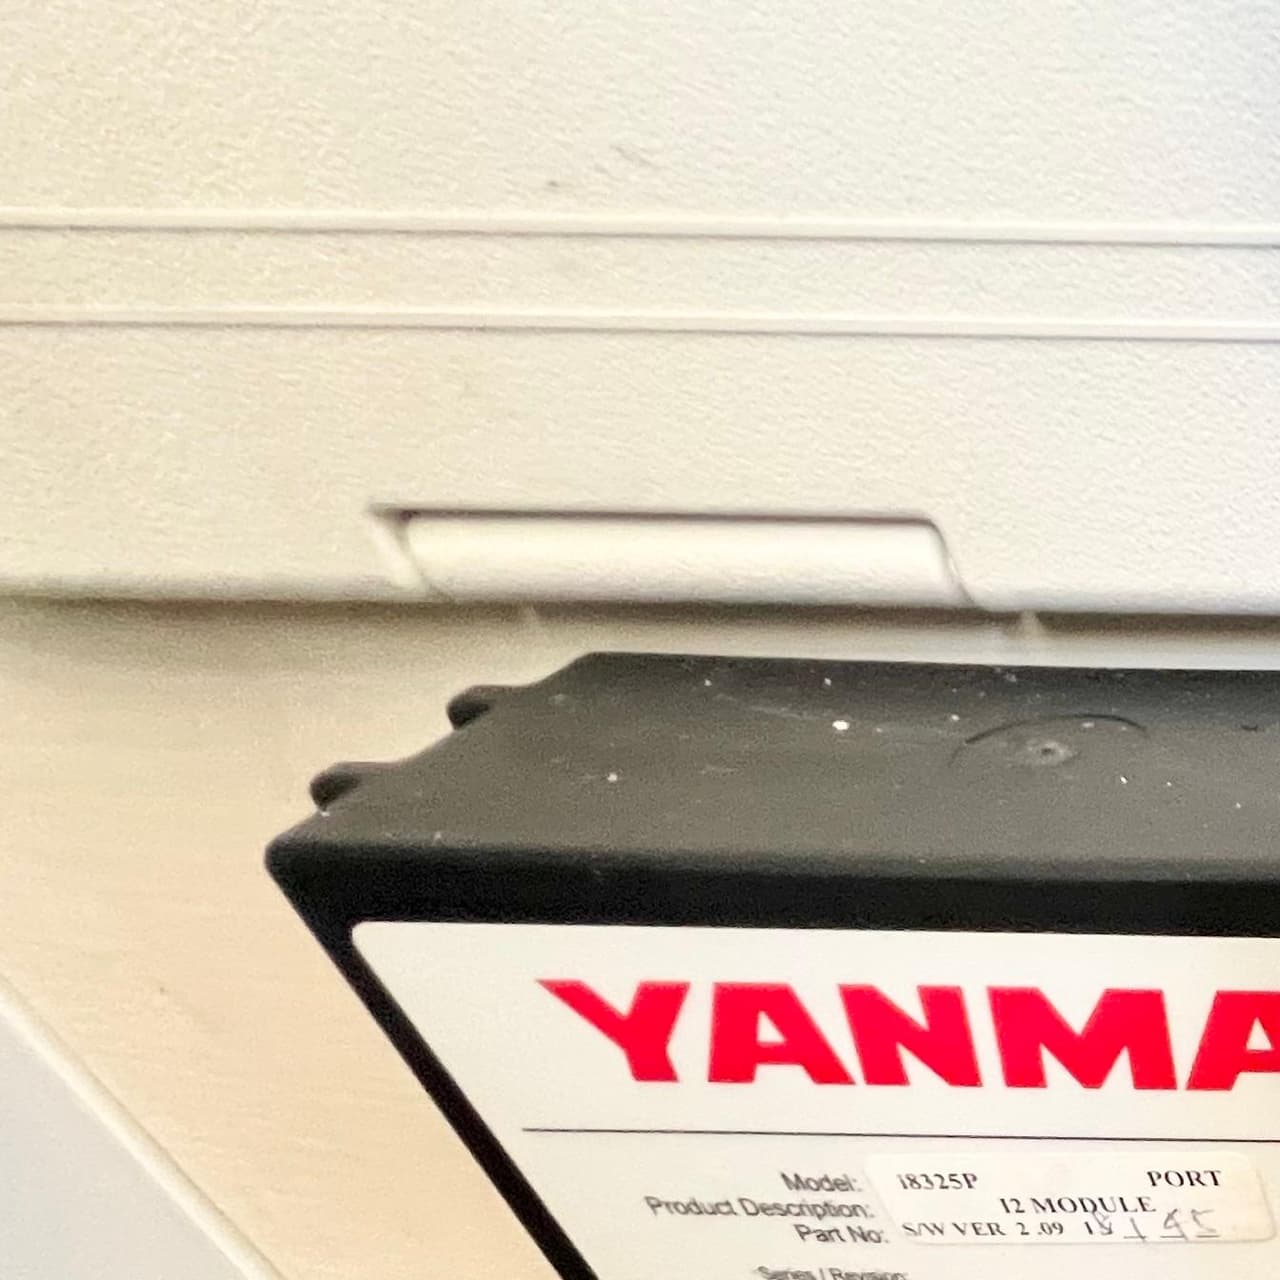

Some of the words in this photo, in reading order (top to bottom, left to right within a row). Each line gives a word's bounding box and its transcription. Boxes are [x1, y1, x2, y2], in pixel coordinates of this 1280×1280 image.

[780, 1171, 862, 1193] Model:
[1147, 1169, 1222, 1187] PORT
[643, 1196, 737, 1216] Product
[739, 1198, 875, 1220] Description:
[1029, 1196, 1157, 1214] MODULE
[793, 1223, 844, 1243] Part
[850, 1225, 890, 1244] No:
[951, 1221, 1007, 1237] VER
